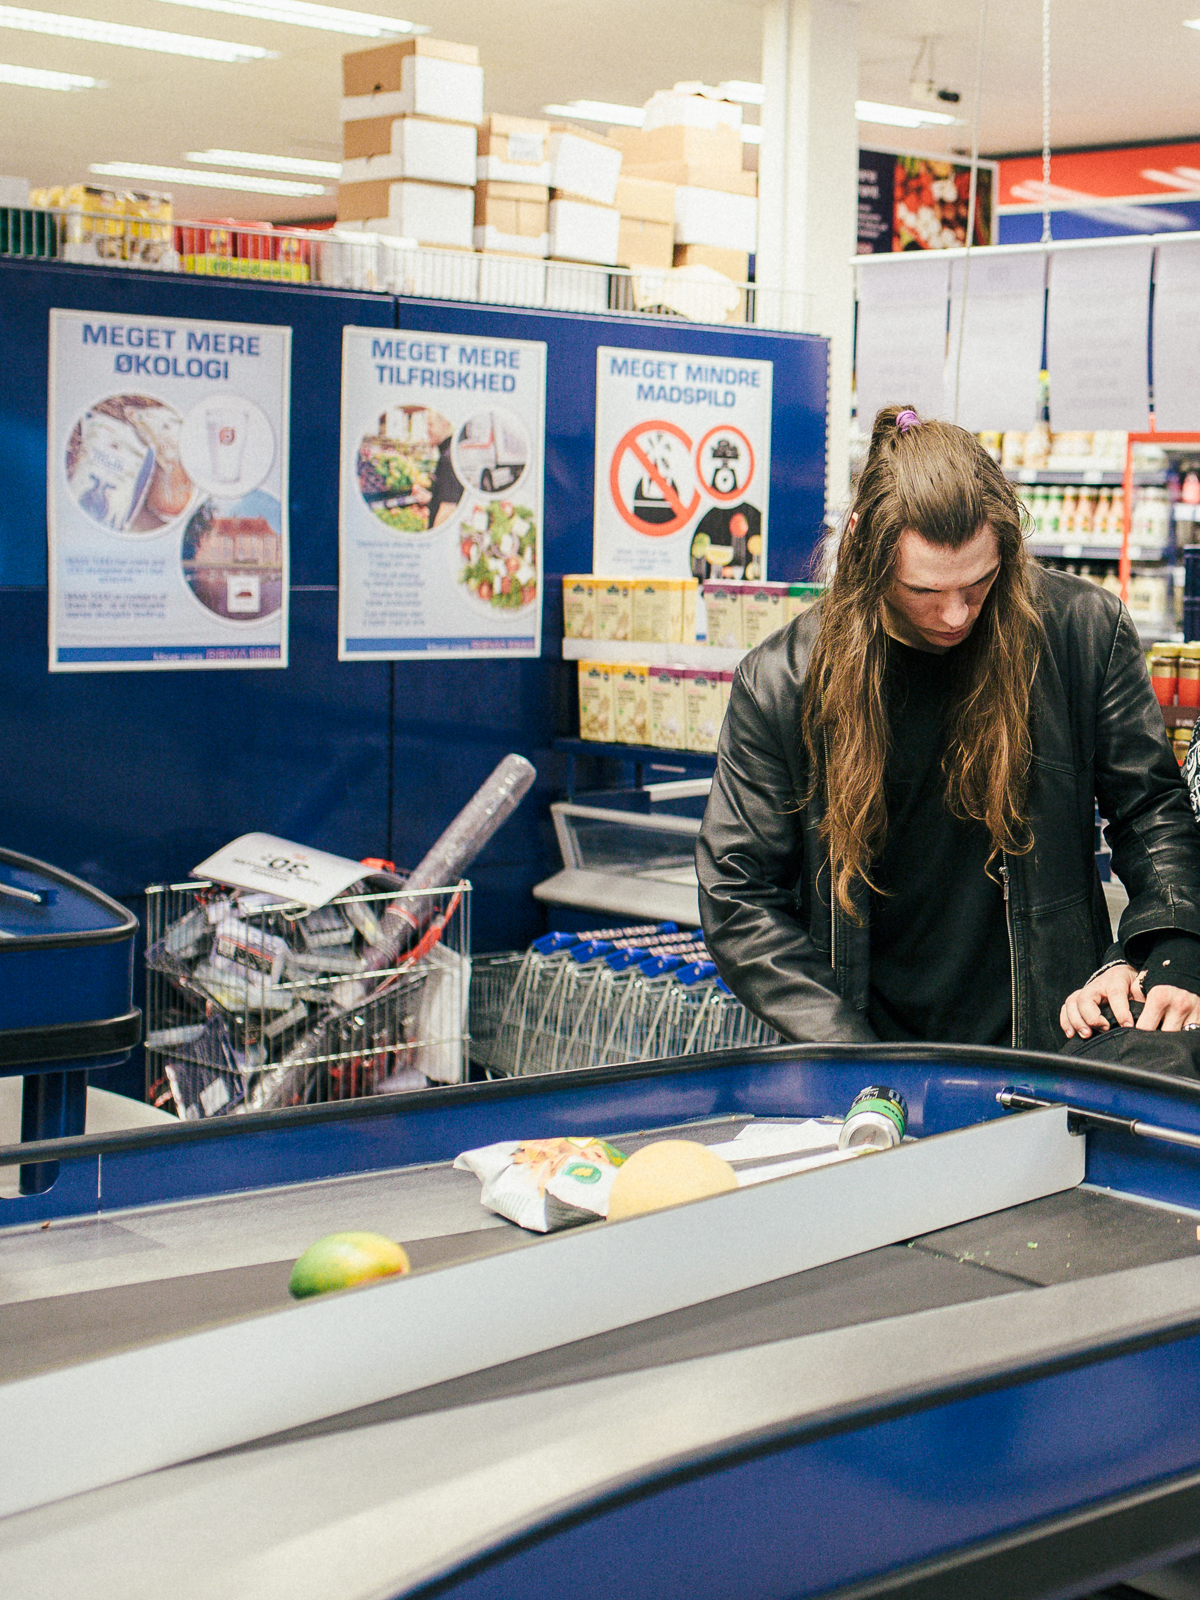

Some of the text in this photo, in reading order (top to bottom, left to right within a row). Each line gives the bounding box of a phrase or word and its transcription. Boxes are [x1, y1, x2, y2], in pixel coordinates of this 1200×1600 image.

[82, 324, 261, 356] MEGET MERE
[371, 339, 521, 370] MEGET MERE
[114, 353, 229, 380] ØKOLOGI
[375, 365, 517, 393] TILFRISKHED
[610, 357, 761, 389] MEGET MINDRE
[636, 384, 737, 408] MADSPILD
